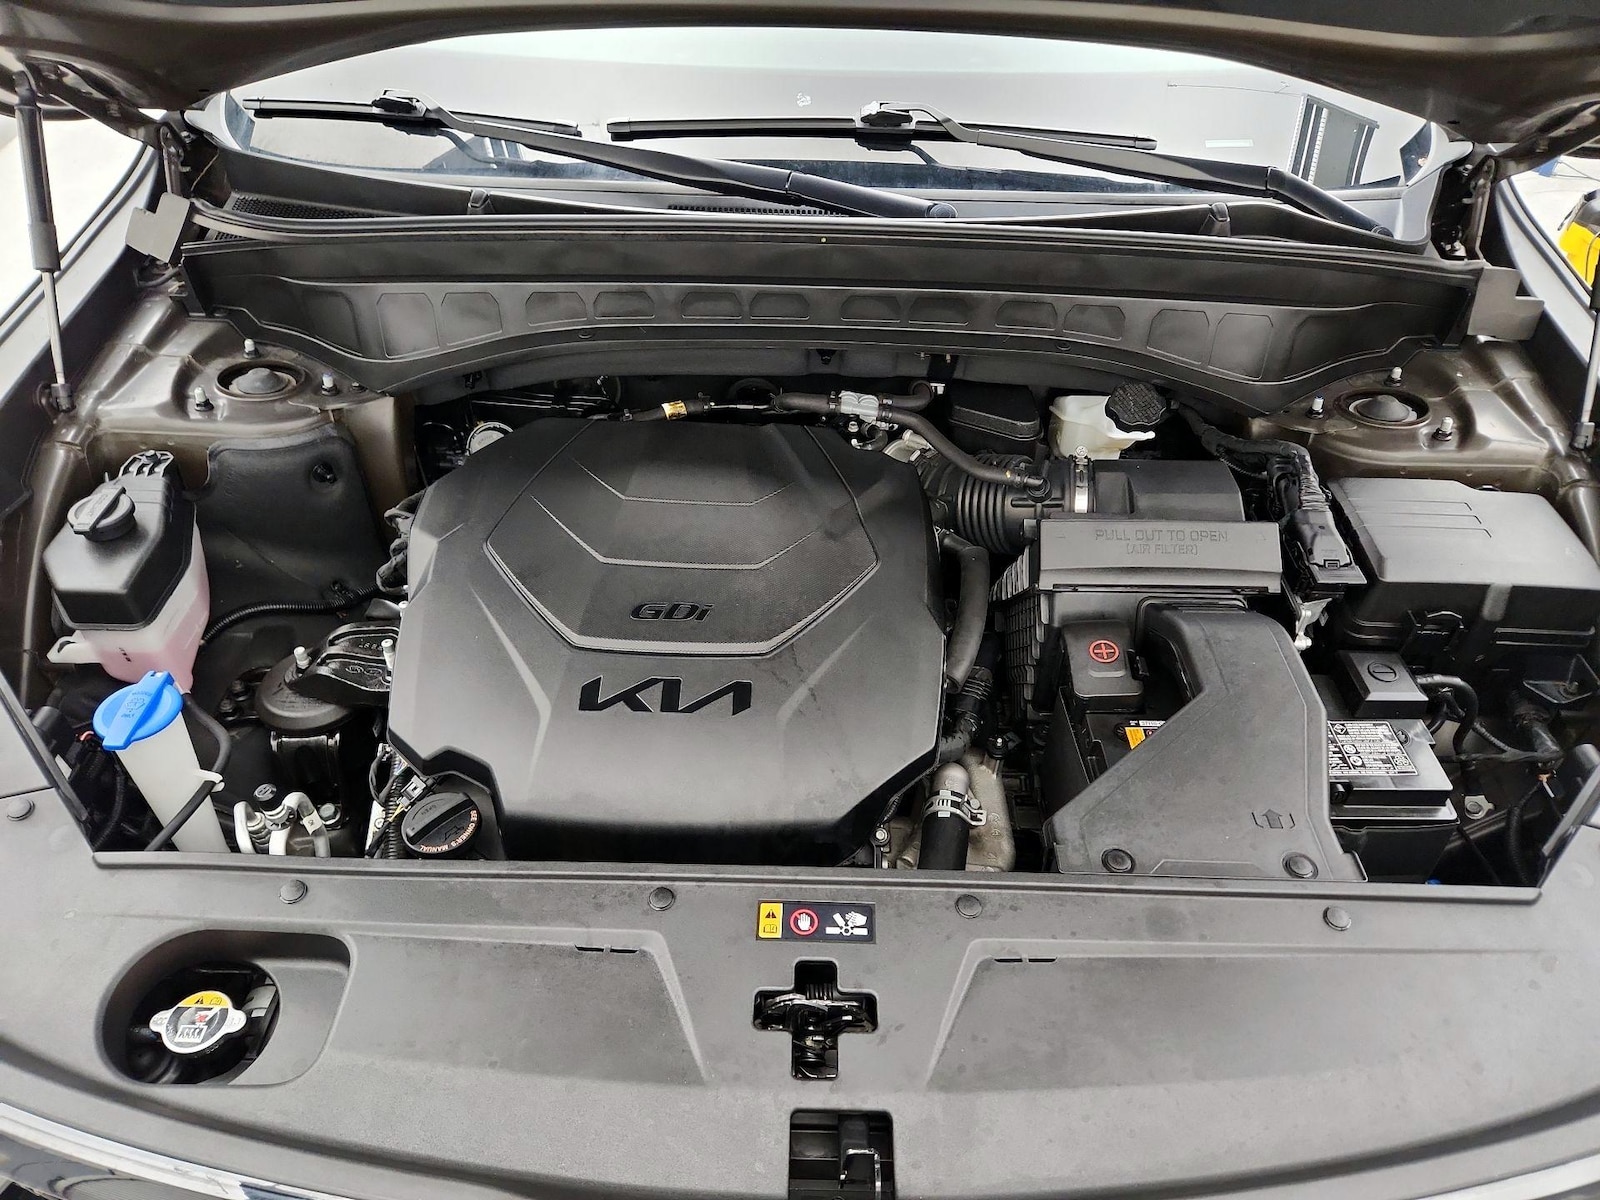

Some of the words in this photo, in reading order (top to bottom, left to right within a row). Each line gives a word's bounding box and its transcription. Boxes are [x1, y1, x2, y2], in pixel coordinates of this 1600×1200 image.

[1095, 529, 1131, 541] PULL
[1135, 529, 1163, 541] OUT
[1165, 530, 1186, 541] TO
[1190, 530, 1228, 542] OPEN
[630, 602, 715, 622] GDi
[578, 675, 753, 717] KIA
[470, 809, 478, 822] SEE
[450, 822, 476, 847] OWNER'S
[420, 844, 449, 853] MANUAL
